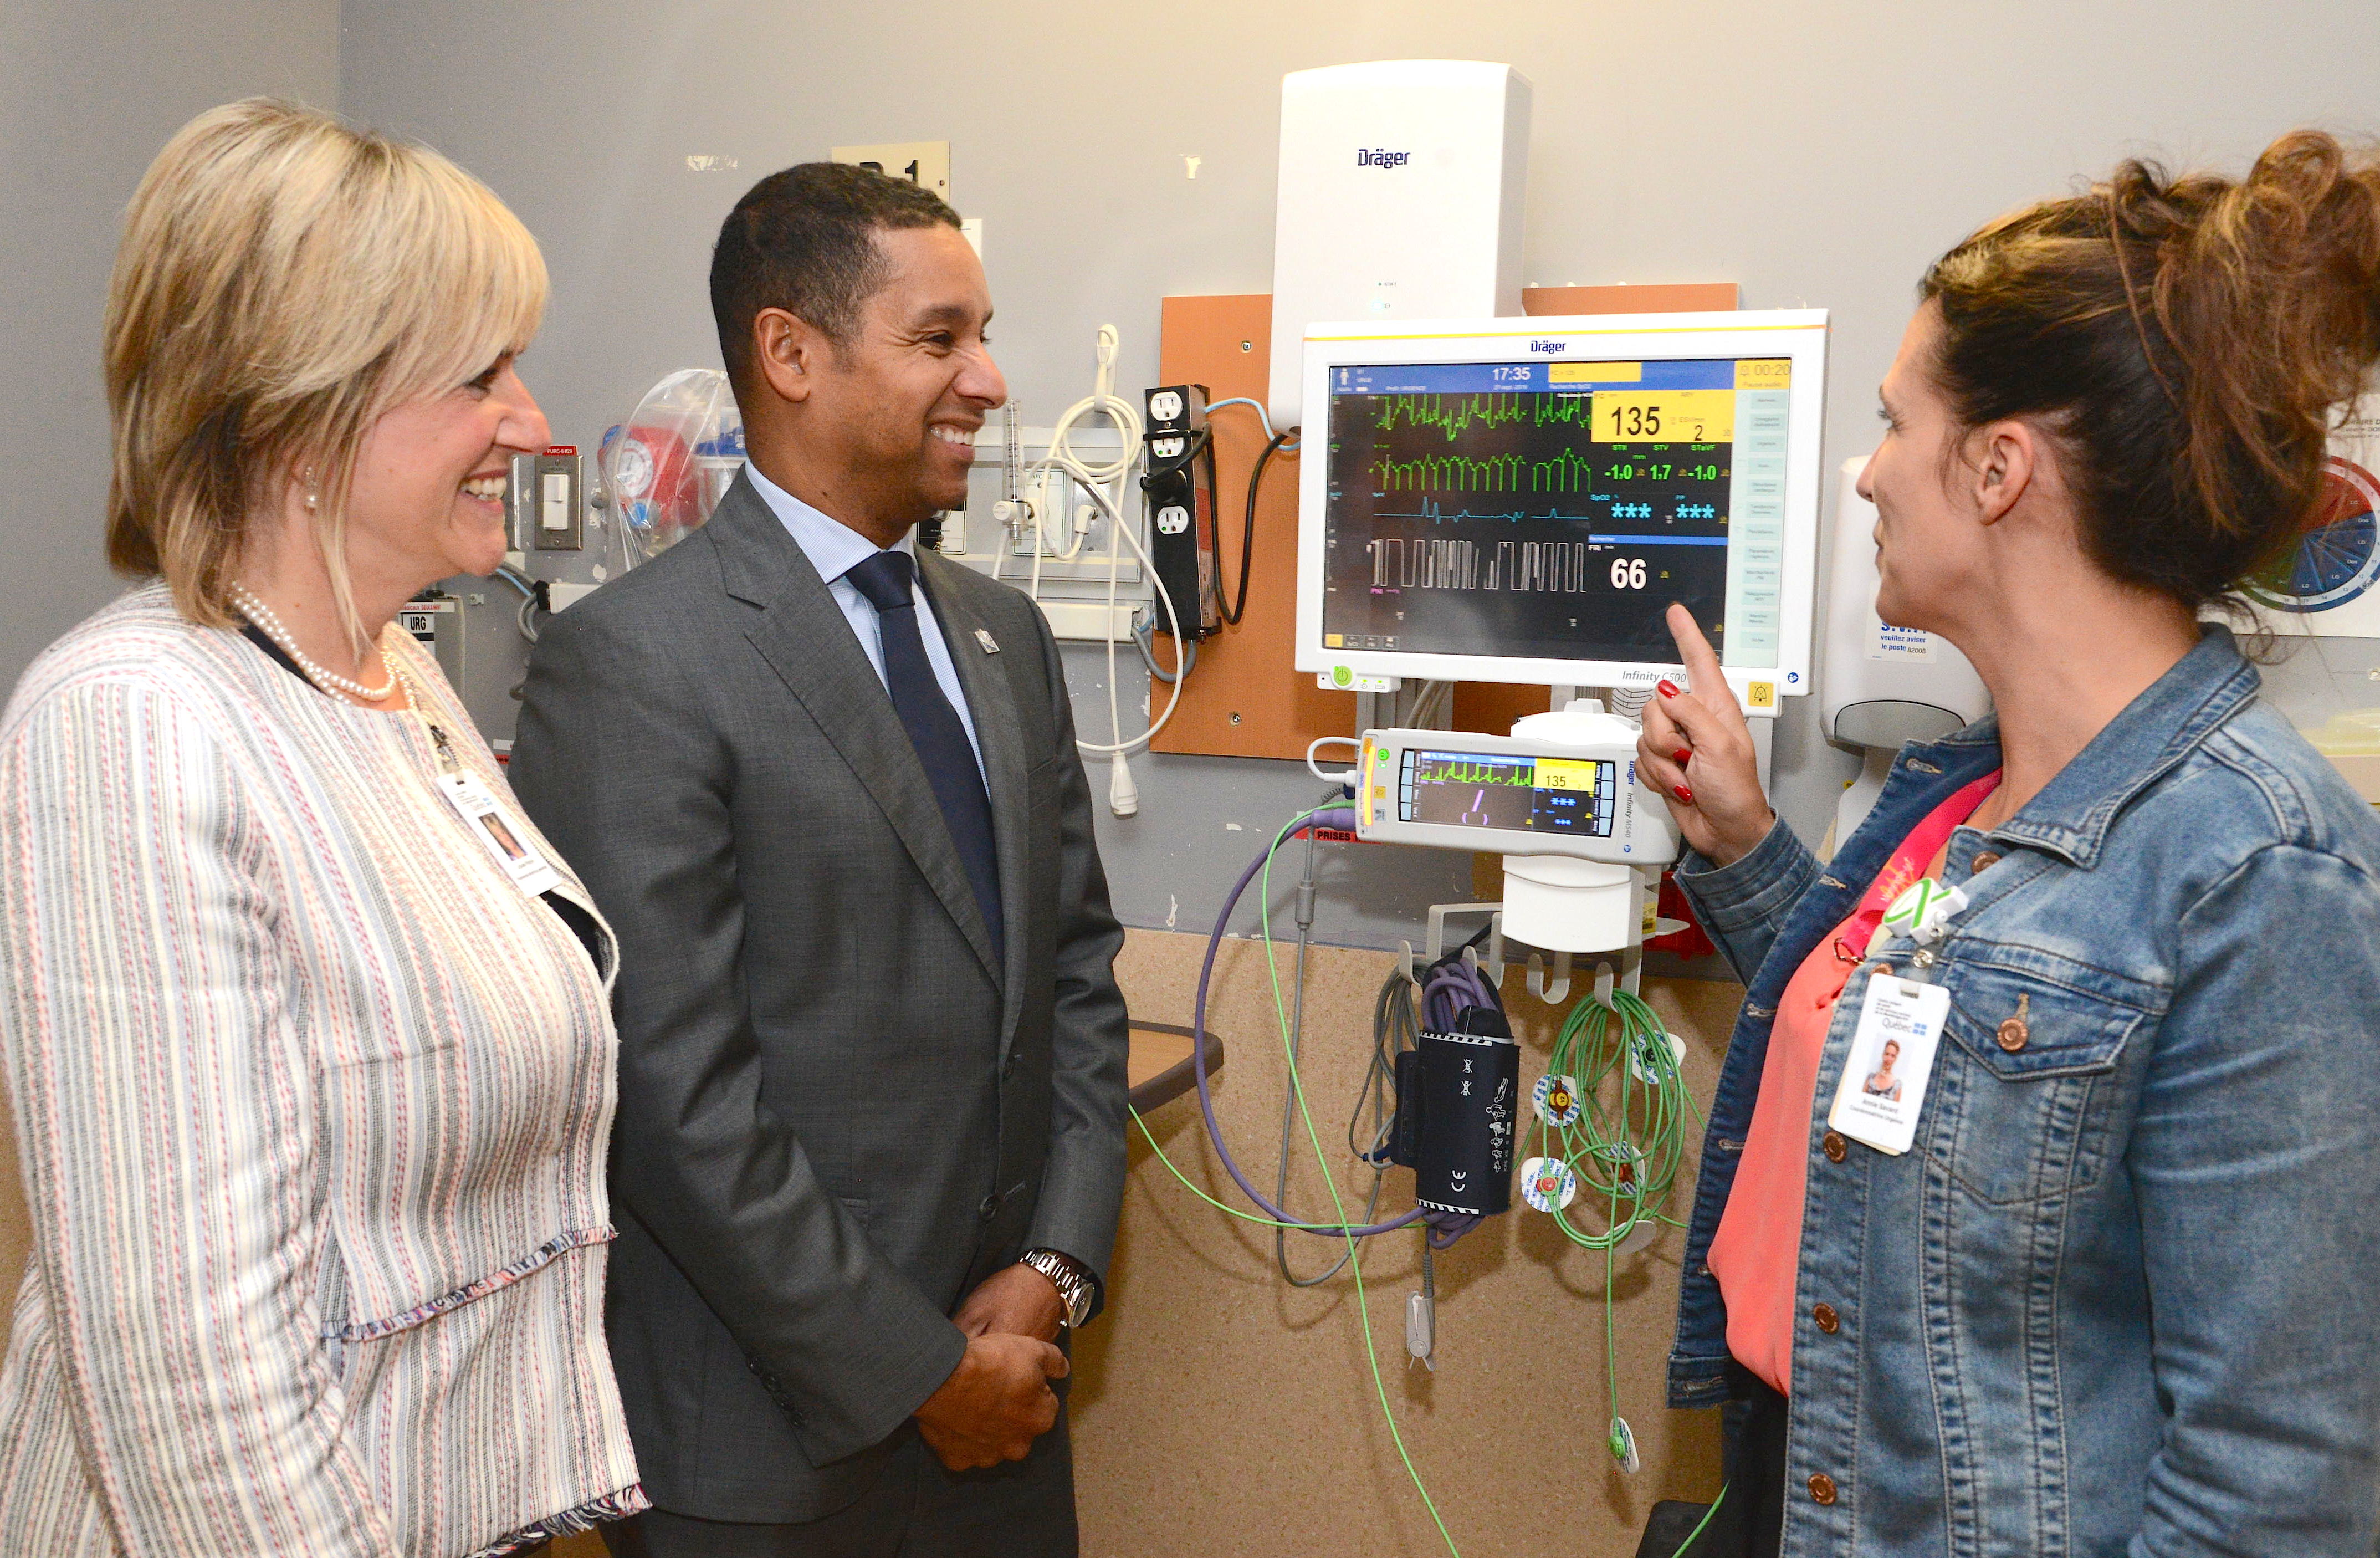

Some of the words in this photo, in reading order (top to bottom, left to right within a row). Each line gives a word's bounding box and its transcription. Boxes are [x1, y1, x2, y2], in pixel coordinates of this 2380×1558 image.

[1358, 148, 1411, 169] Dräger
[1531, 340, 1567, 354] Dräger
[1492, 367, 1531, 381] 17:35
[1754, 364, 1789, 376] 00:20
[1611, 406, 1660, 436] 135
[1694, 425, 1703, 441] 2
[1610, 558, 1647, 590] 66
[410, 616, 426, 631] URG
[1622, 670, 1660, 682] Infinity
[1662, 672, 1687, 682] C500
[1546, 775, 1566, 787] 135
[1625, 792, 1634, 818] Infinity
[1317, 831, 1350, 841] PRISES
